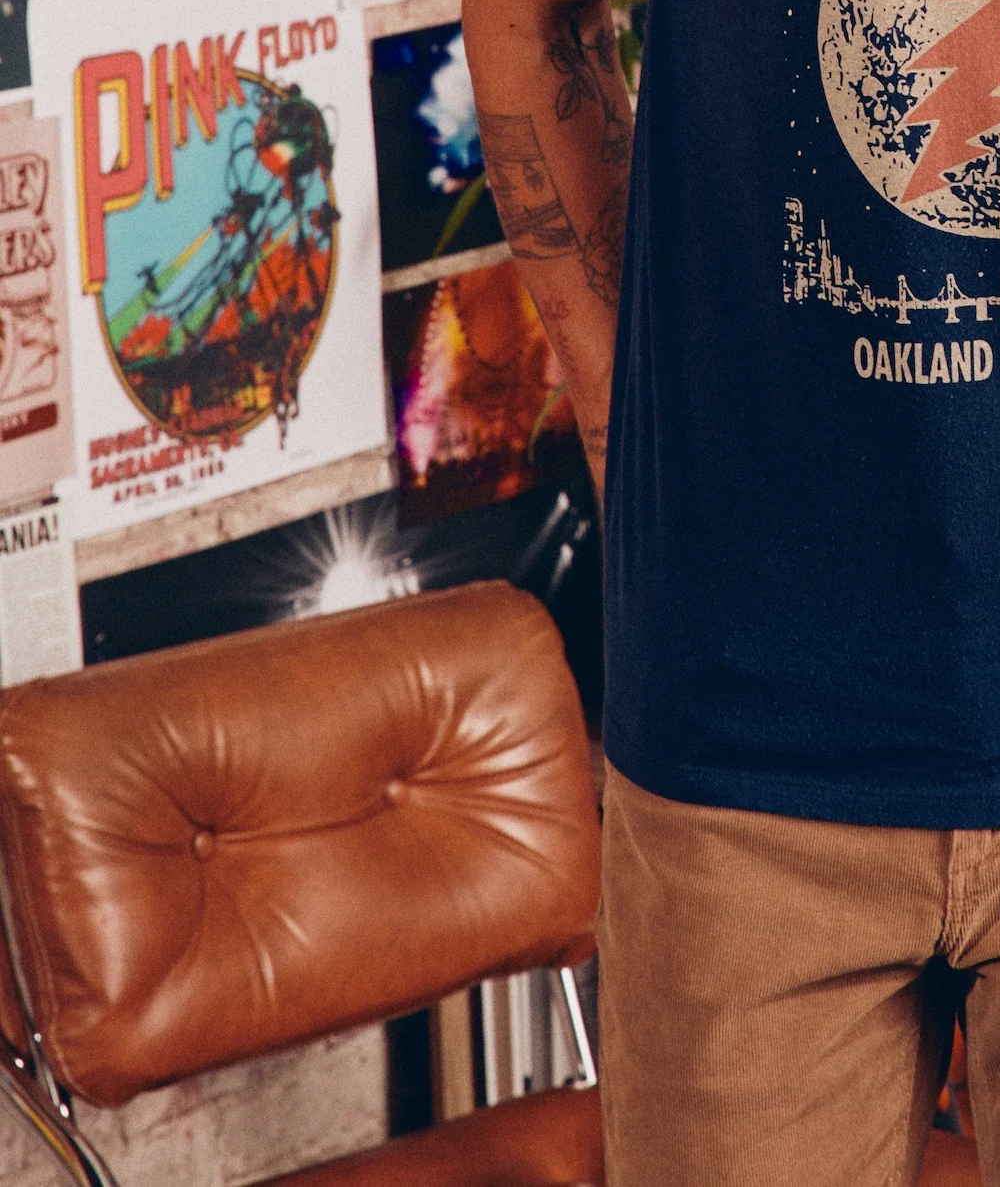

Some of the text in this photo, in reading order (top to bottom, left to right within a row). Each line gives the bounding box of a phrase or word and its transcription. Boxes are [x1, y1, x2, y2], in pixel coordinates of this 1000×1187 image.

[73, 16, 338, 295] PINK FLOYD
[853, 336, 993, 385] OAKLAND
